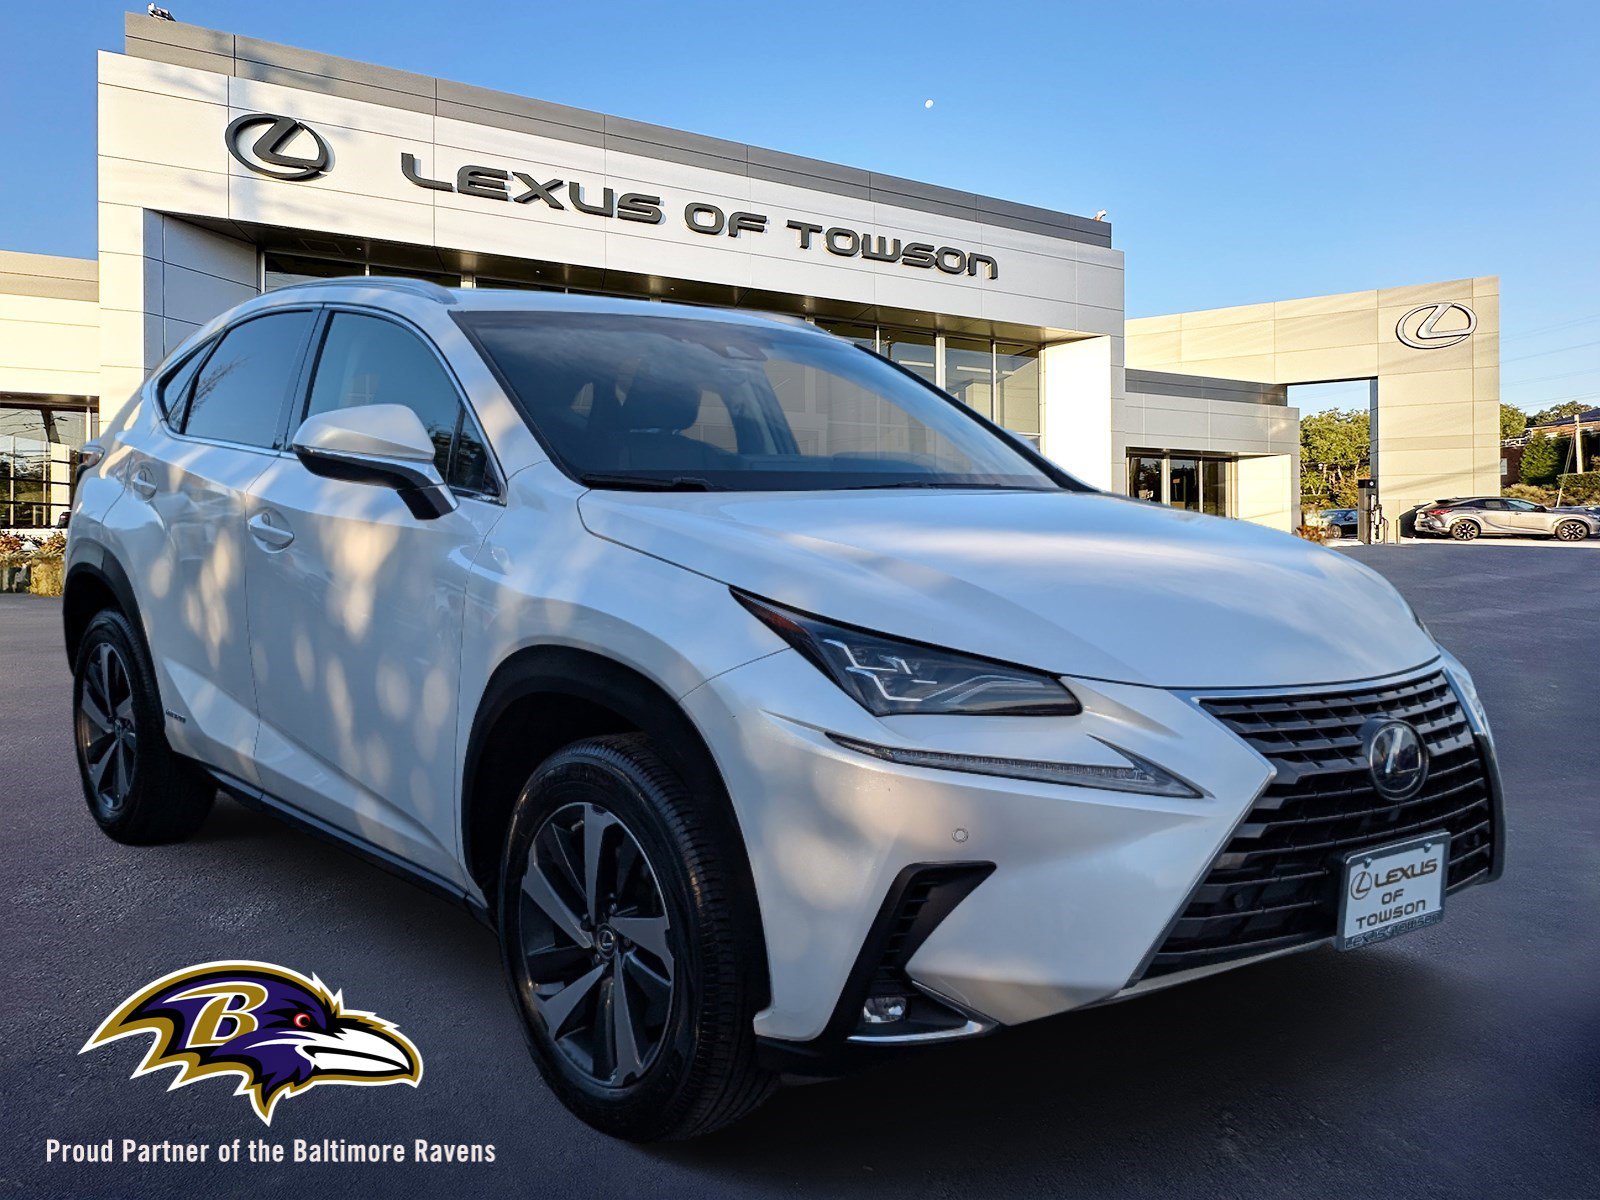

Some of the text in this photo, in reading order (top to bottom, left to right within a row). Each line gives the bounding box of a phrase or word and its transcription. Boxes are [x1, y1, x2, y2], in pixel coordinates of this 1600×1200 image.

[400, 152, 999, 280] LEXUS OF TOWSON
[1374, 858, 1438, 888] LEXUS
[1381, 888, 1404, 905] OF
[1355, 899, 1426, 929] TOWSON
